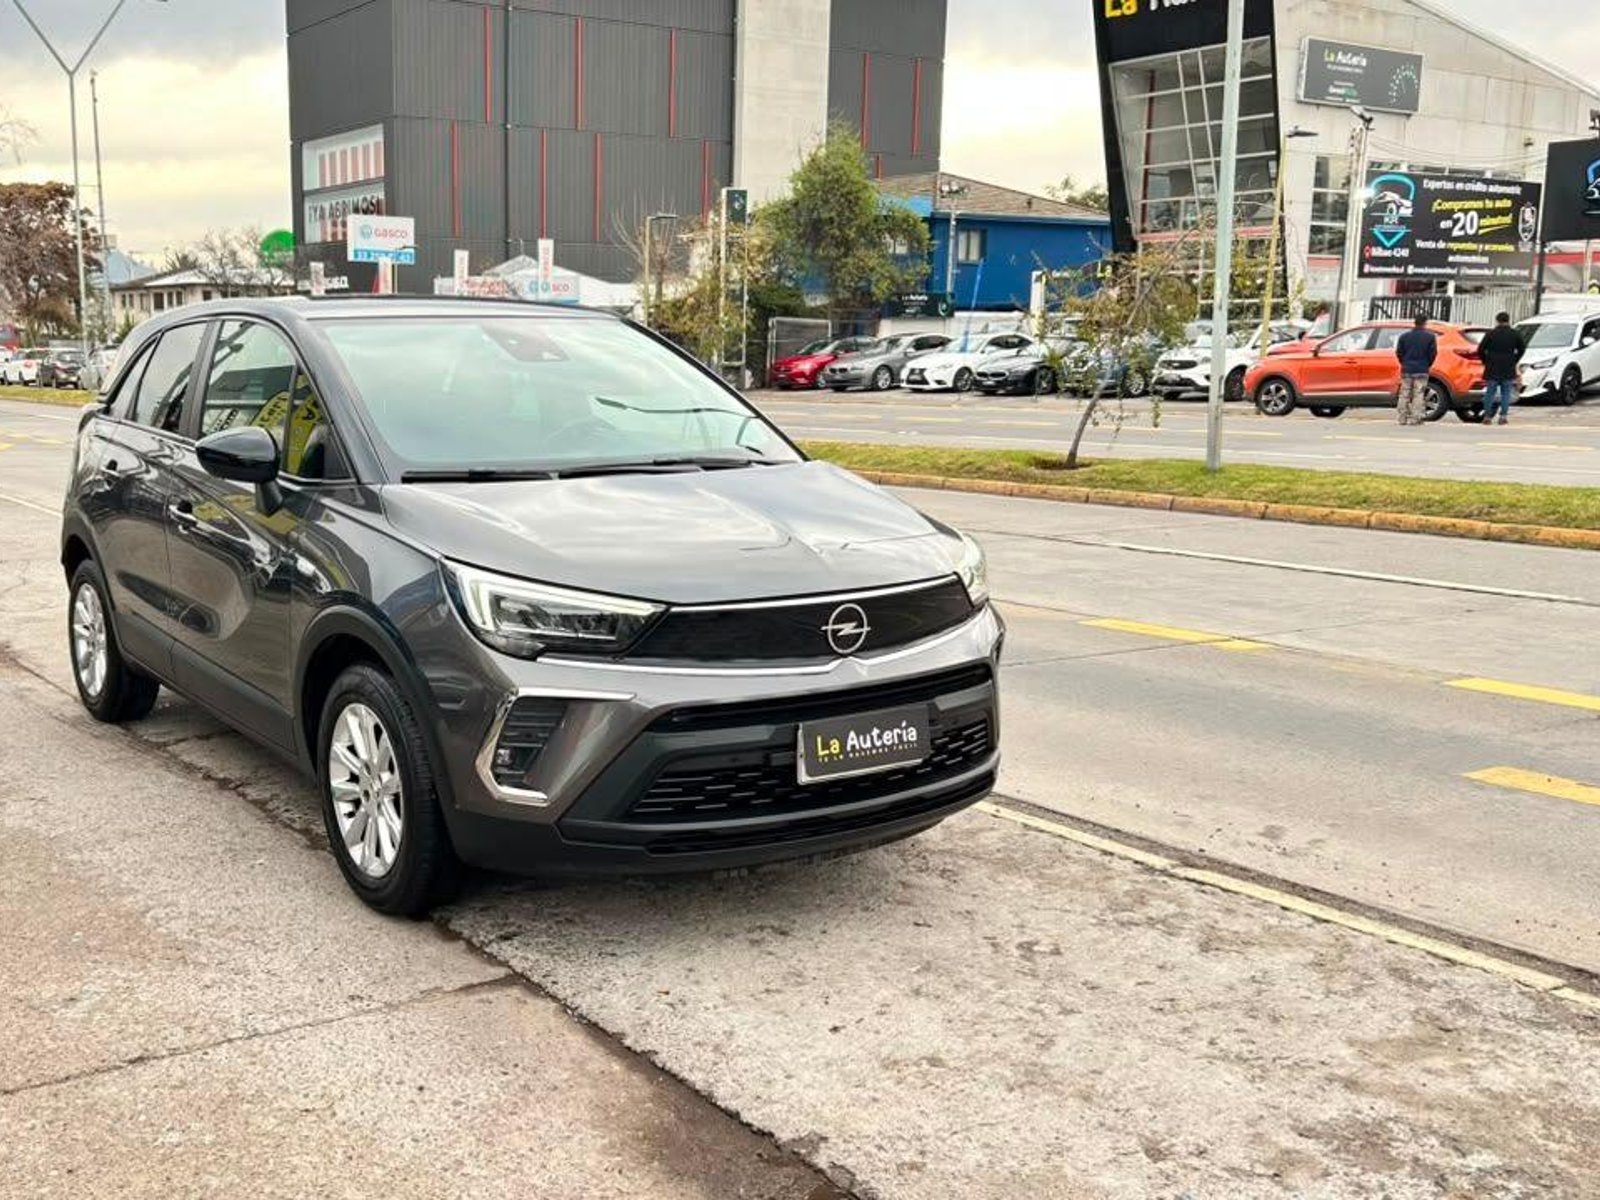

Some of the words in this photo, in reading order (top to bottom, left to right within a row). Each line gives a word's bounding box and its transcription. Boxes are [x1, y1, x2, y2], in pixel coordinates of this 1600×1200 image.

[1440, 219, 1452, 229] en
[1451, 210, 1478, 237] 20
[816, 735, 841, 756] La
[846, 720, 918, 751] Autería
